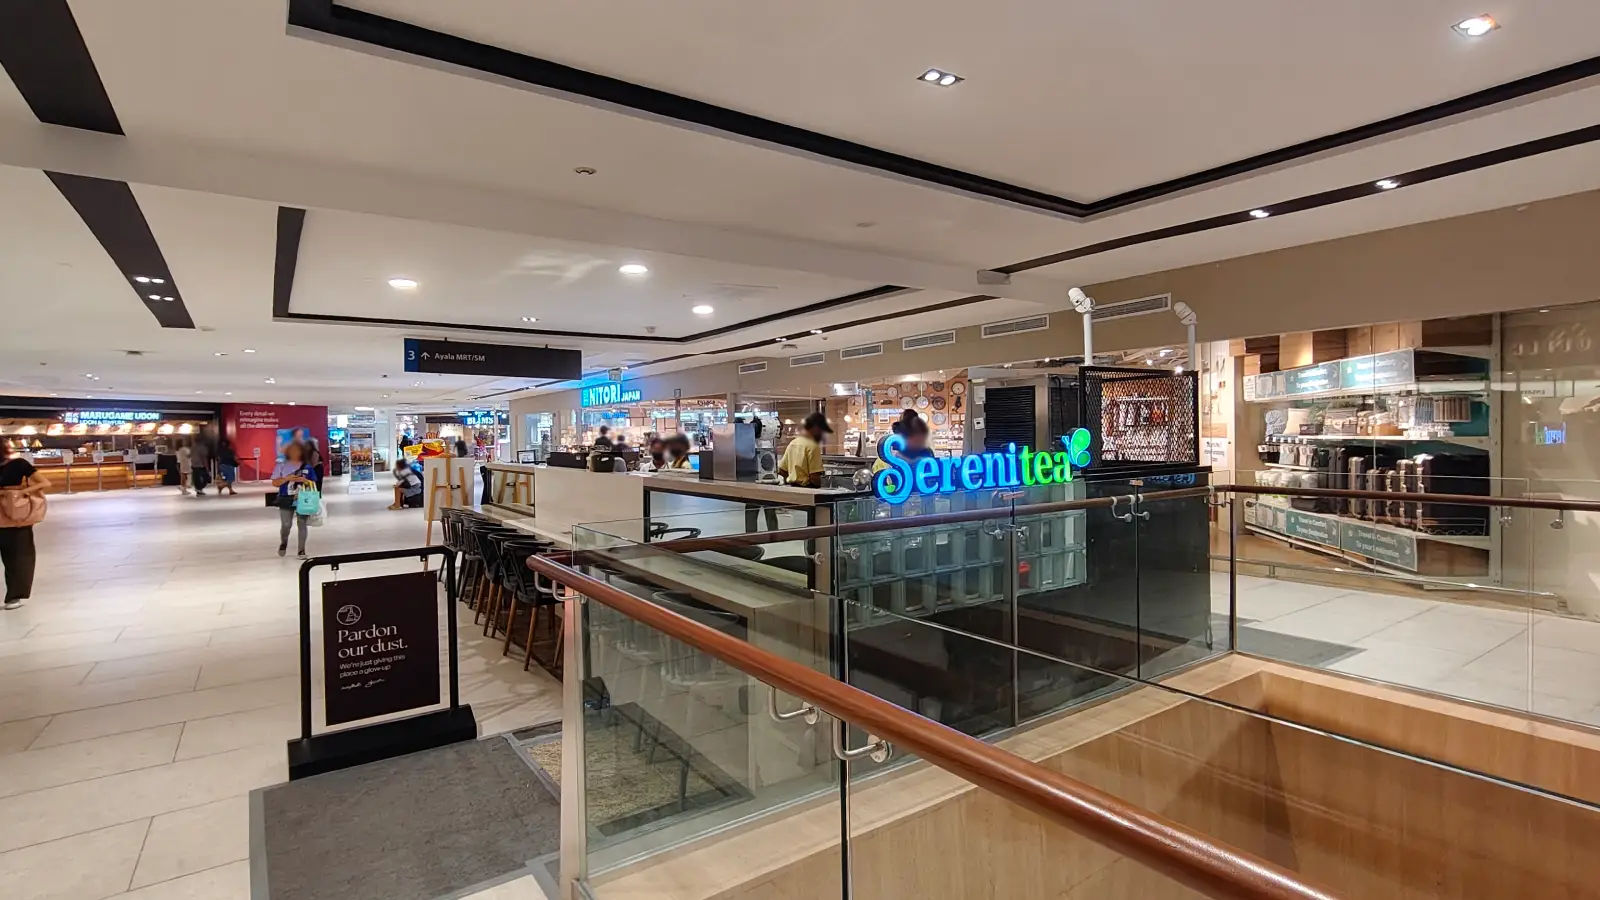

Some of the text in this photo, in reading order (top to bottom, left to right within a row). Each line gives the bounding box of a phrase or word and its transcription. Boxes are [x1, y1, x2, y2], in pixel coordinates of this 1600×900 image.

[407, 350, 415, 360] 3
[434, 352, 486, 362] Ayala MRT/SM
[589, 383, 621, 406] NITORI
[621, 390, 641, 402] JAPAN
[80, 411, 134, 420] MARUGAME
[134, 412, 160, 420] UDON
[874, 433, 1074, 505] Serenitea
[1357, 529, 1372, 539] Travel
[338, 624, 397, 643] Pardon
[338, 638, 408, 658] our dust.
[339, 661, 360, 670] We're
[360, 659, 373, 669] just
[373, 656, 393, 666] giving
[339, 669, 358, 679] place
[364, 664, 391, 675] glow-up
